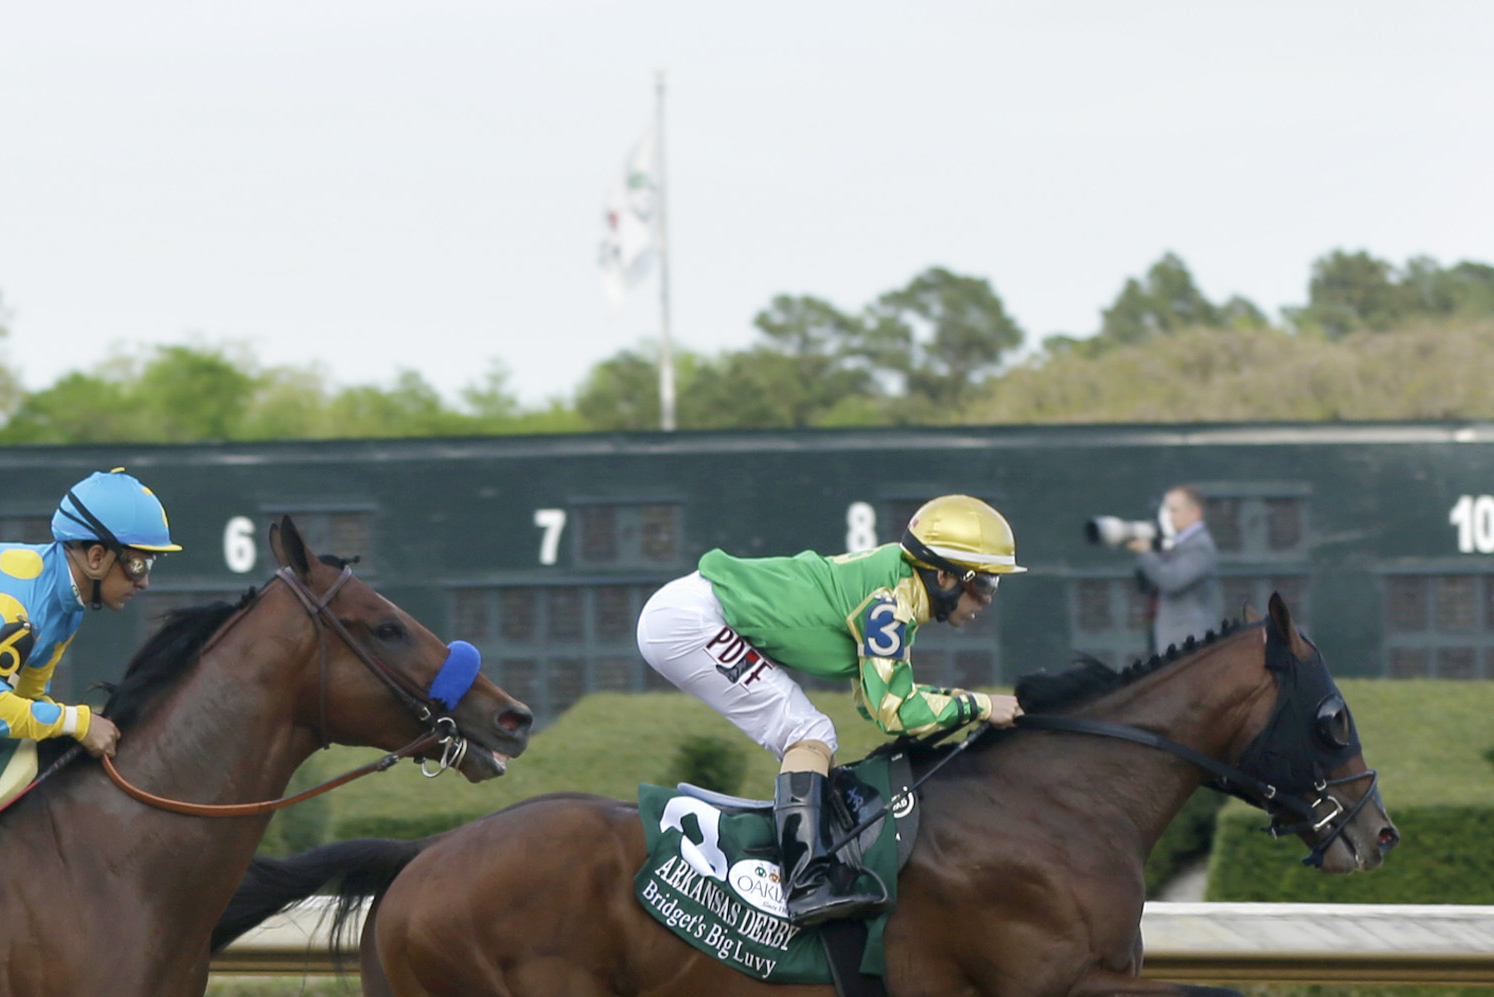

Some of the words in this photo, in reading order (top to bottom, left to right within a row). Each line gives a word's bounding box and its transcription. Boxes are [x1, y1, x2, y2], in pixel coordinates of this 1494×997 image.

[223, 515, 256, 573] 6
[534, 508, 566, 565] 7
[846, 502, 877, 553] 8
[1449, 494, 1494, 553] 10
[868, 603, 901, 656] 3
[642, 879, 708, 939] Bridget's
[704, 923, 736, 960] Big
[733, 940, 777, 979] Luvy
[655, 855, 742, 928] ARKANSAS
[738, 908, 802, 952] DERBY
